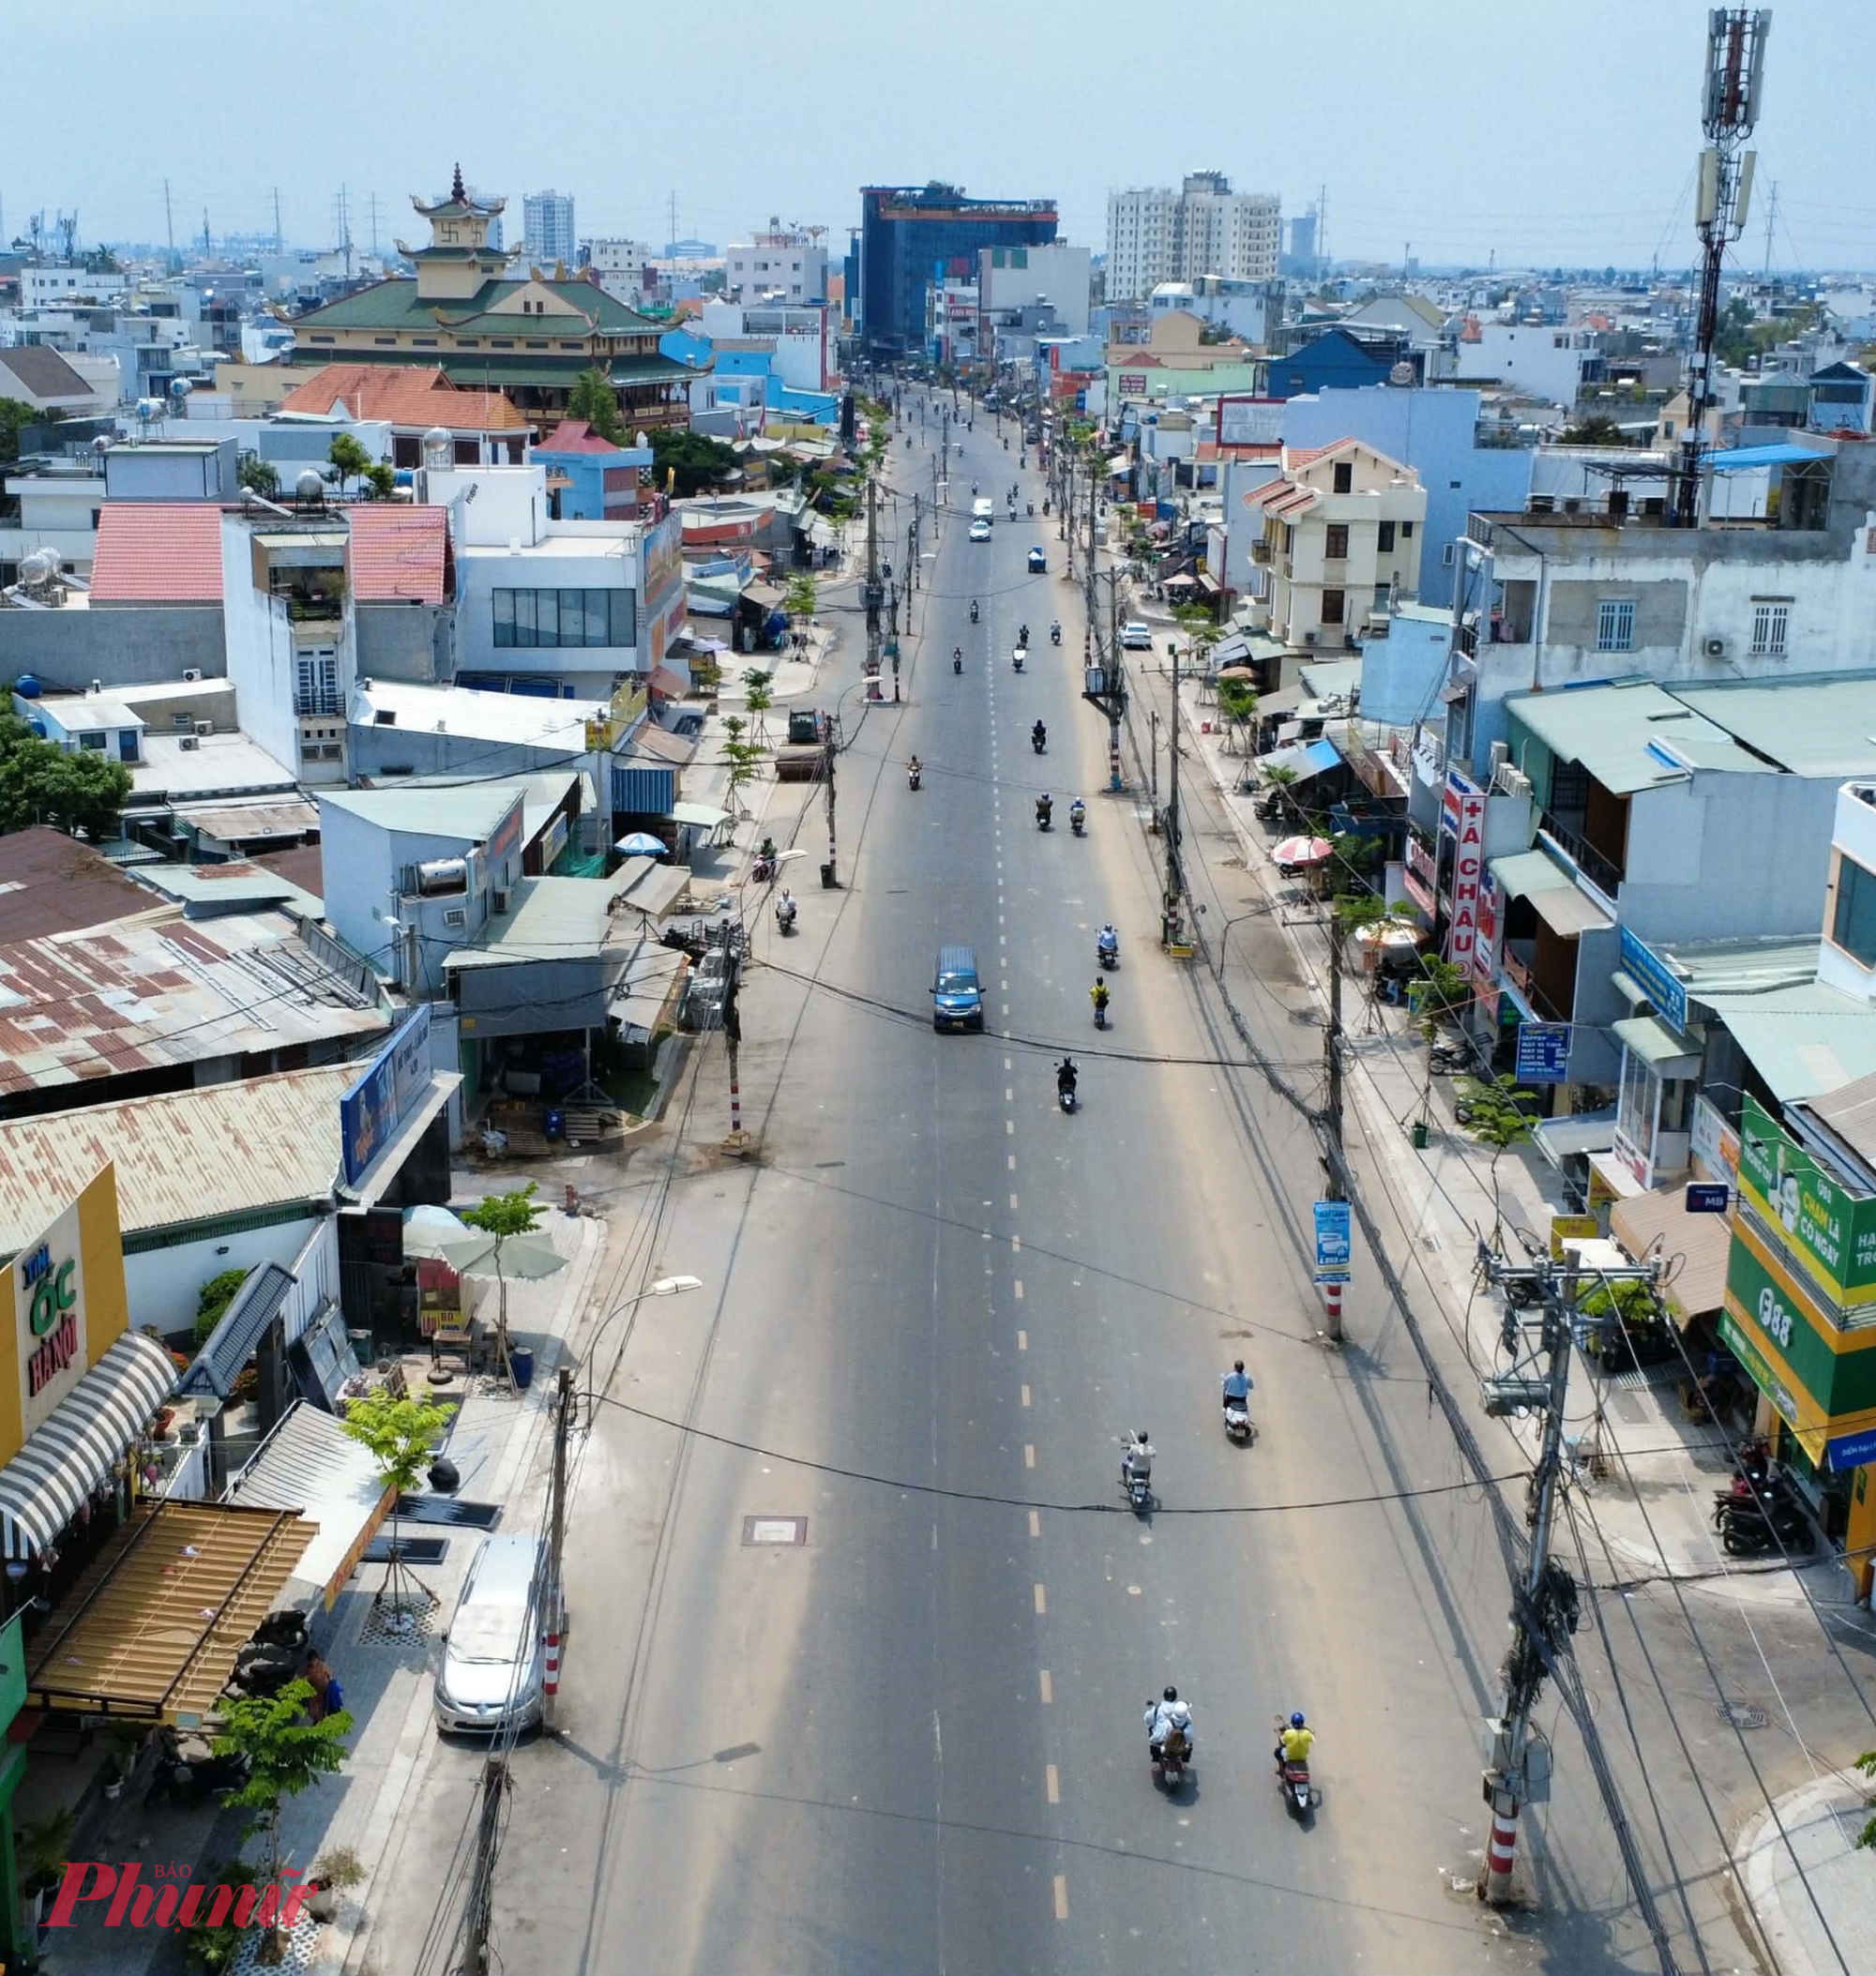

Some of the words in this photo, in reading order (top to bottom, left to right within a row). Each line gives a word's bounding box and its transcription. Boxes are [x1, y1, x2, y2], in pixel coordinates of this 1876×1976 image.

[1461, 822, 1479, 844] Á
[1704, 1196, 1724, 1208] MB
[1801, 1215, 1814, 1242] CÓ
[1814, 1229, 1839, 1268] NGAY
[30, 1258, 77, 1336] ỐC
